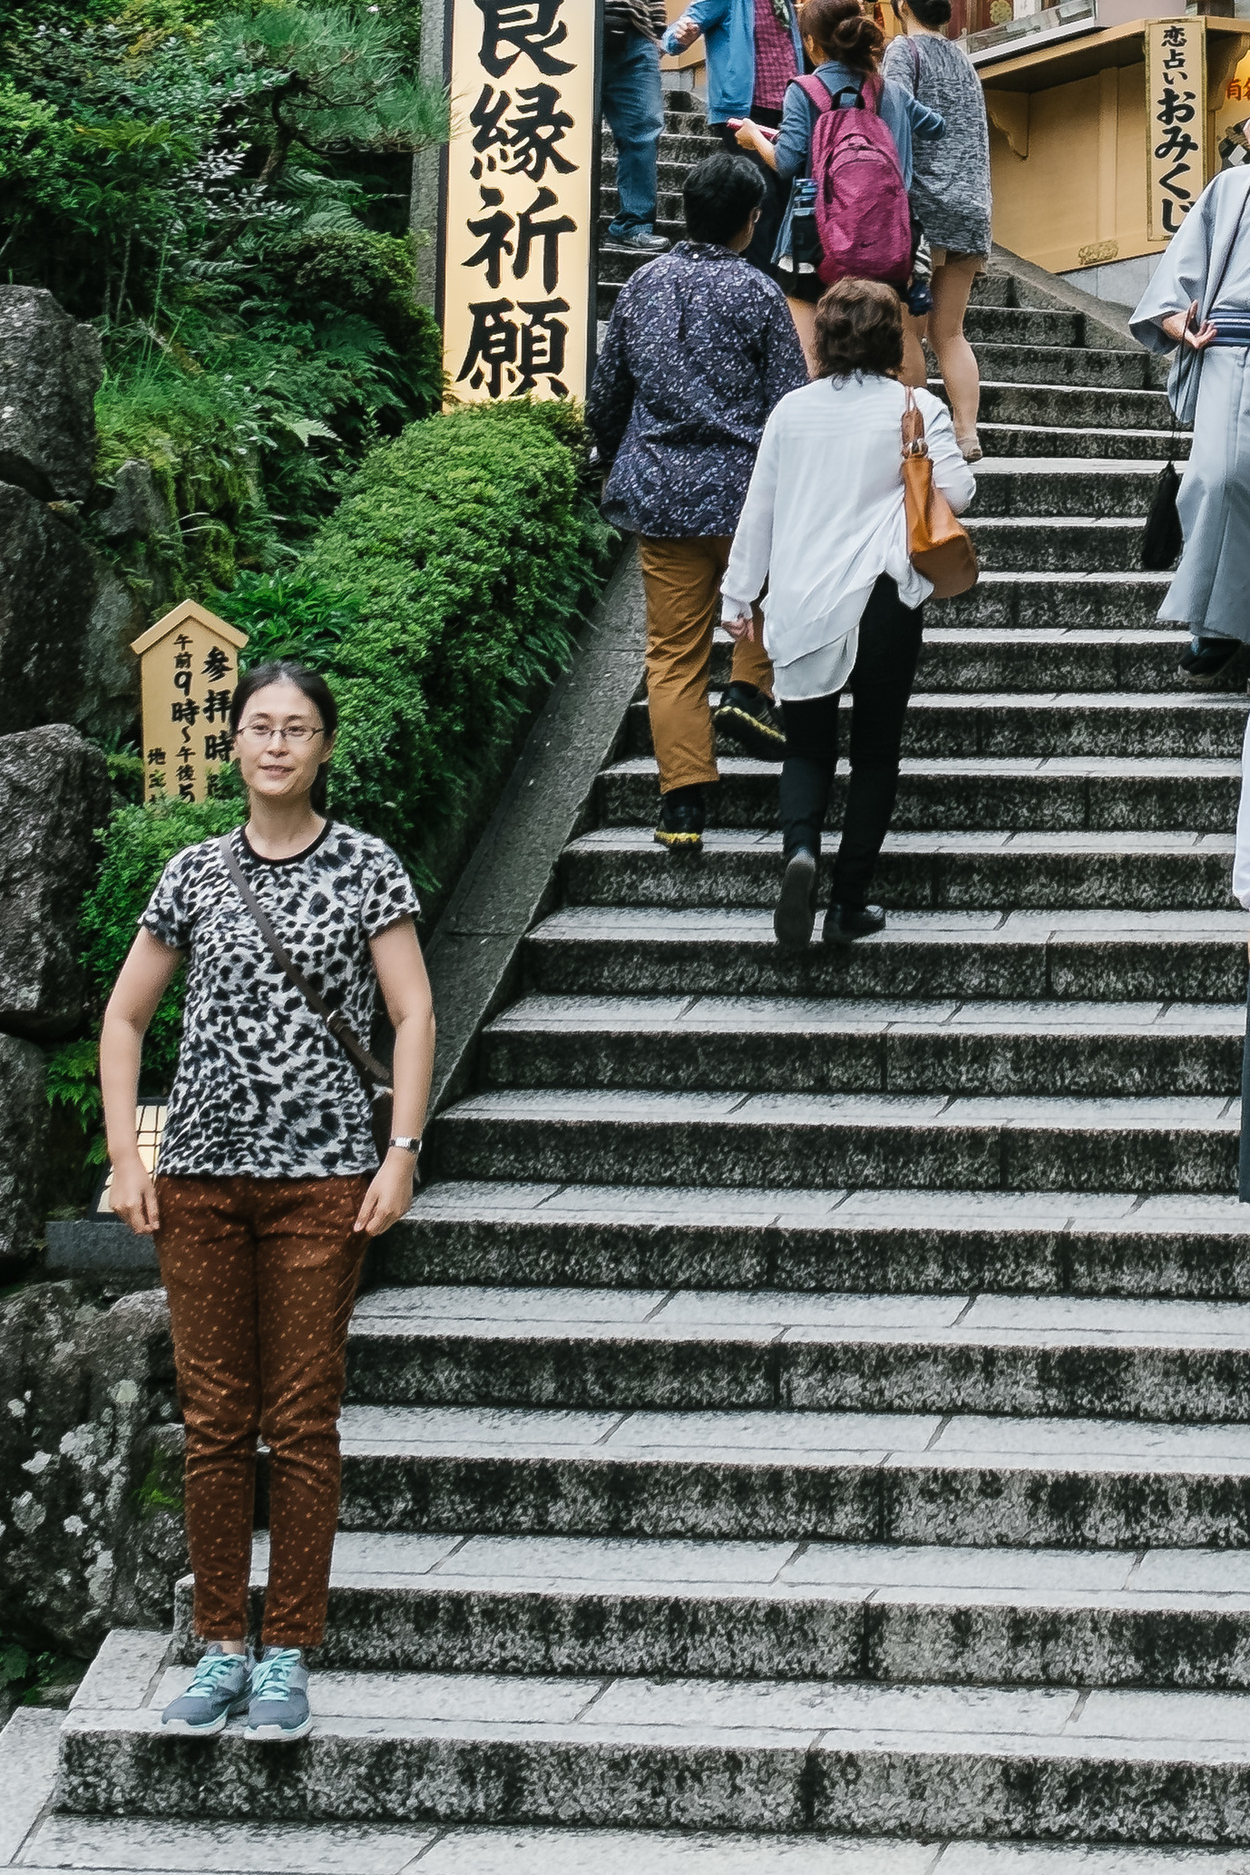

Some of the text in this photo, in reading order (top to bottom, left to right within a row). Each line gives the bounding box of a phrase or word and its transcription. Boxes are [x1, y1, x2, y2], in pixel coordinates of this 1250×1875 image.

[1154, 25, 1199, 234] 恋占いおみくじ
